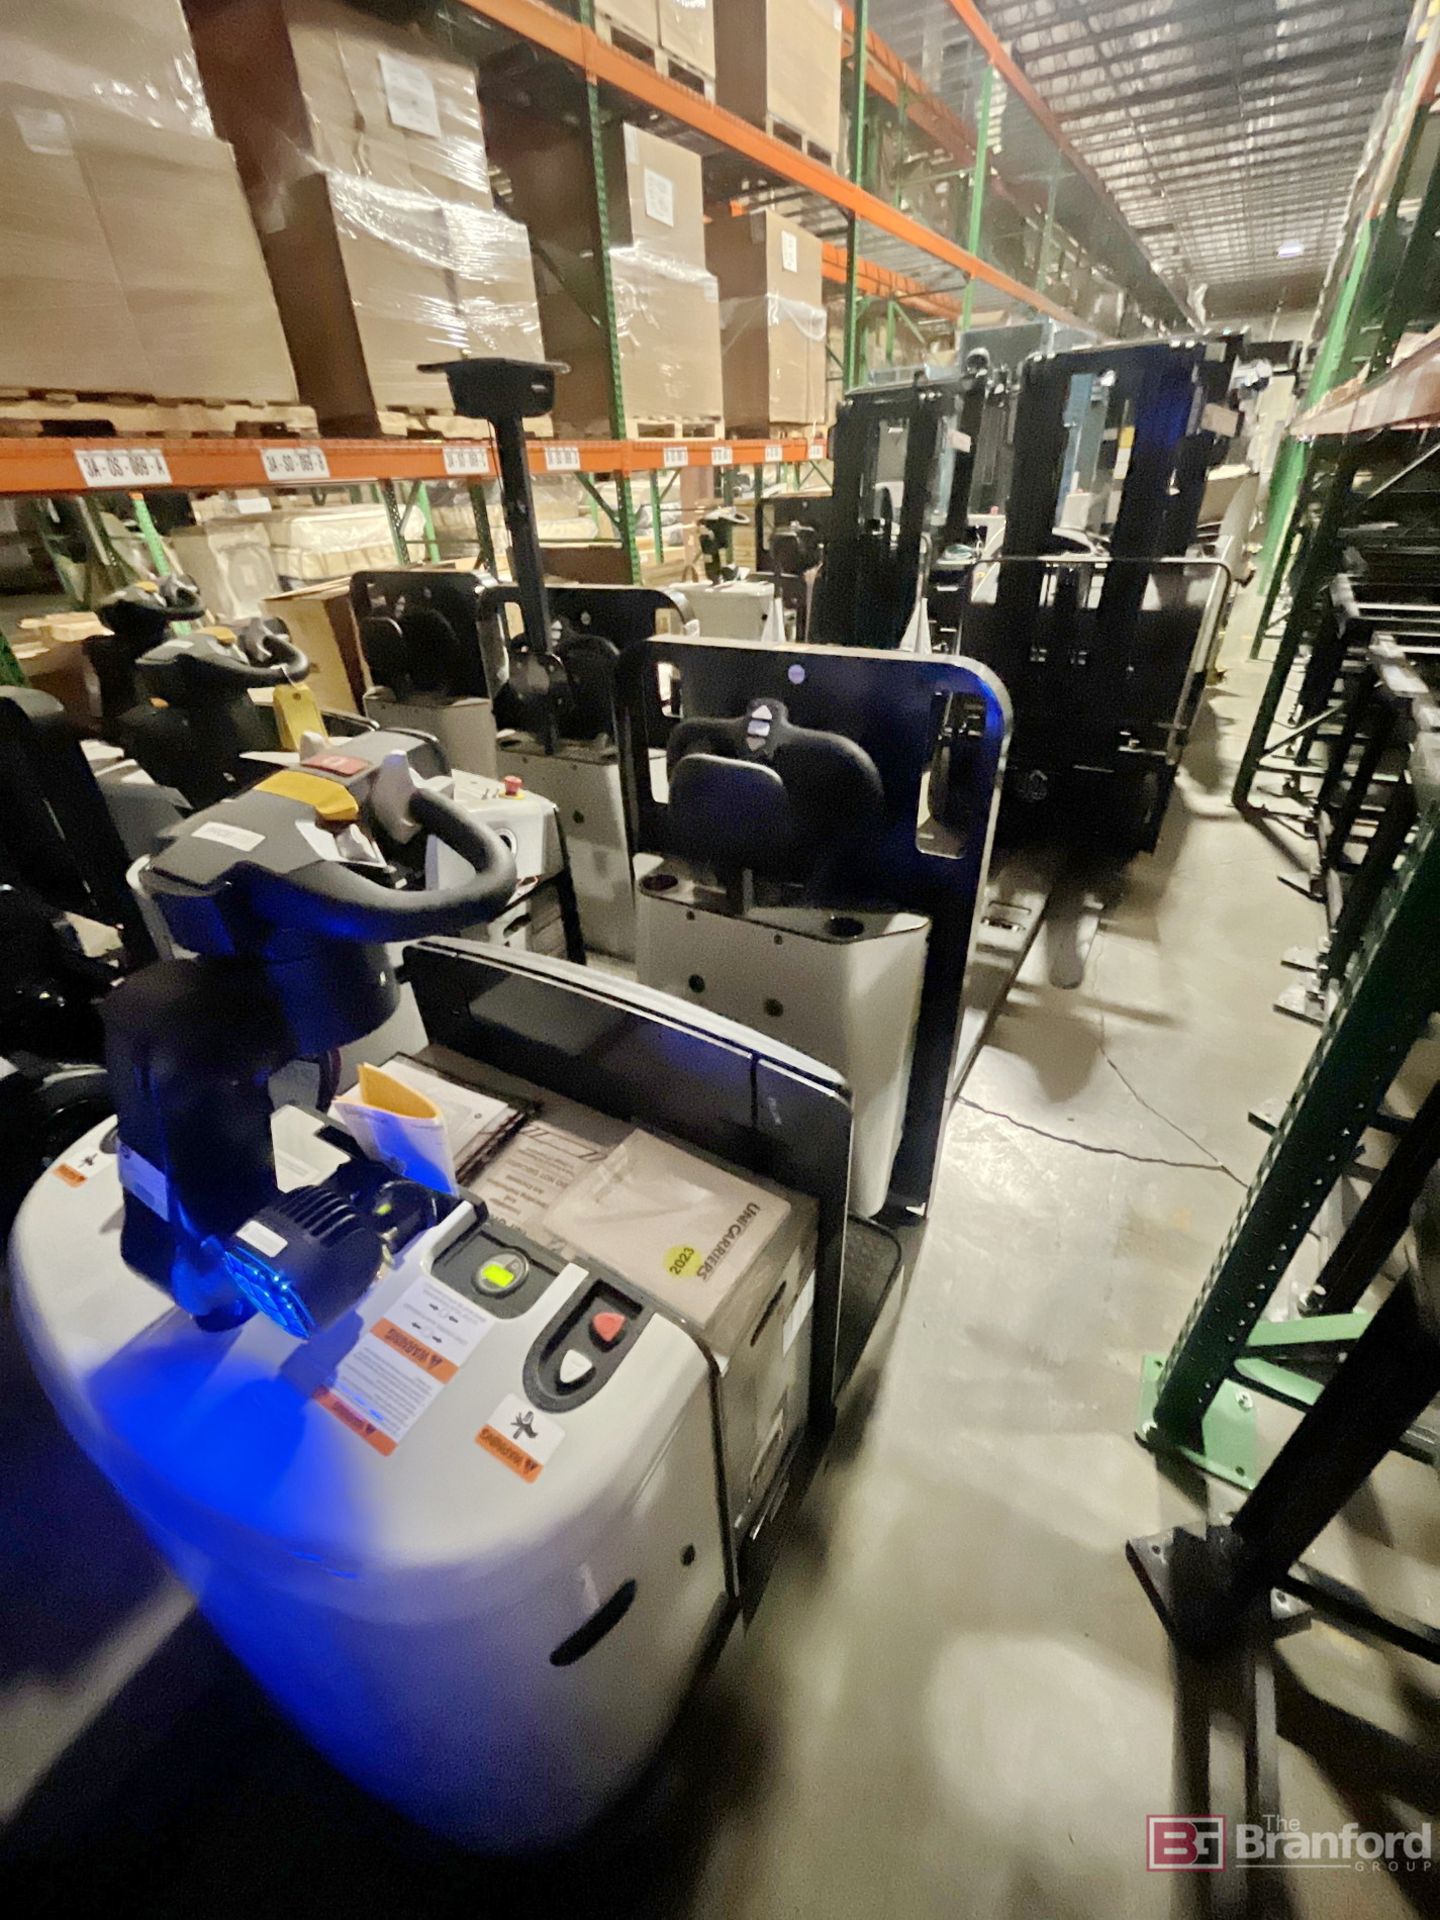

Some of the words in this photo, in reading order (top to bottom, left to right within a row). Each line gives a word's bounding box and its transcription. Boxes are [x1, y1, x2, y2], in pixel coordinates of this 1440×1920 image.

[696, 1202, 761, 1281] UNICARRIERS
[669, 1247, 695, 1275] 2023
[383, 1327, 430, 1363] WARNING
[478, 1426, 523, 1466] WARNING
